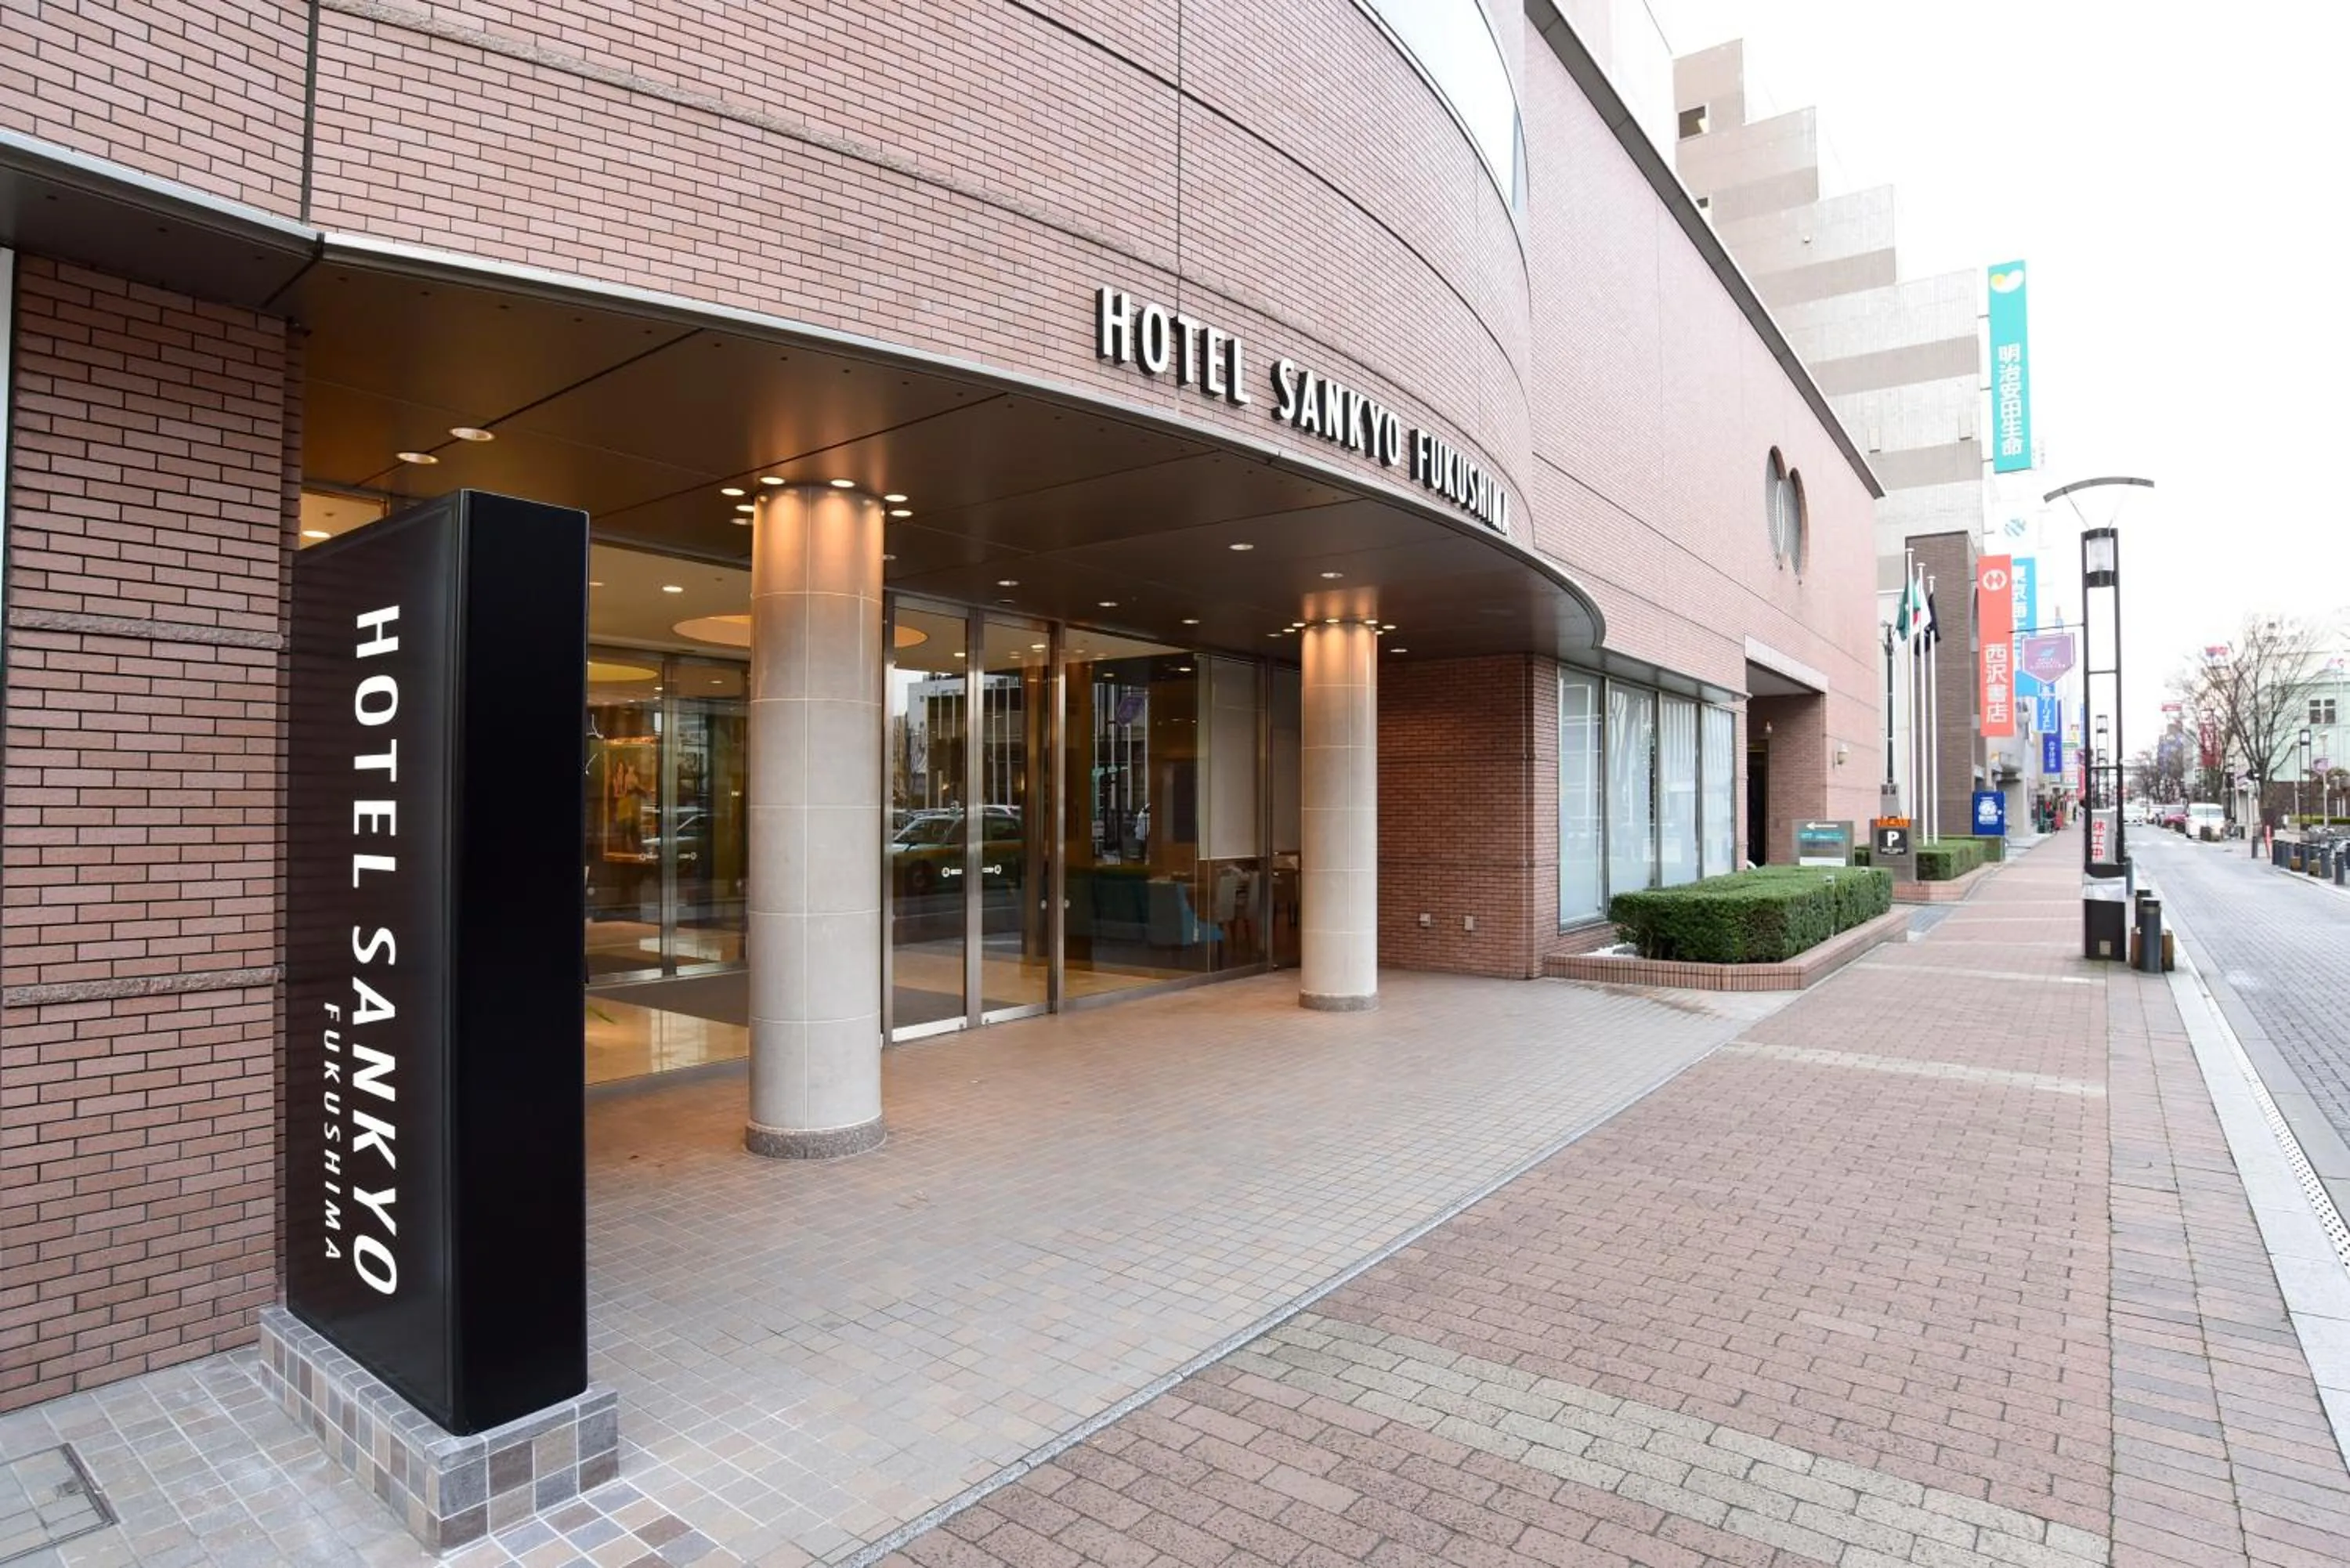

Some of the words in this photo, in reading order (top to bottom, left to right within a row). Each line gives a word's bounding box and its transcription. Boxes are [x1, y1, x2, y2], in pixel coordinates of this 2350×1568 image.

[1098, 285, 1251, 406] HOTEL
[1273, 358, 1401, 467] SANKYO
[1412, 430, 1509, 536] FUKUSHIMA
[1998, 342, 2023, 455] 明治安田生命
[352, 605, 400, 889] HOTEL
[1985, 644, 2008, 724] 西沢書店
[1887, 831, 1900, 847] P
[324, 1001, 342, 1259] FUKUSHIMA
[352, 925, 397, 1295] SANKYO
